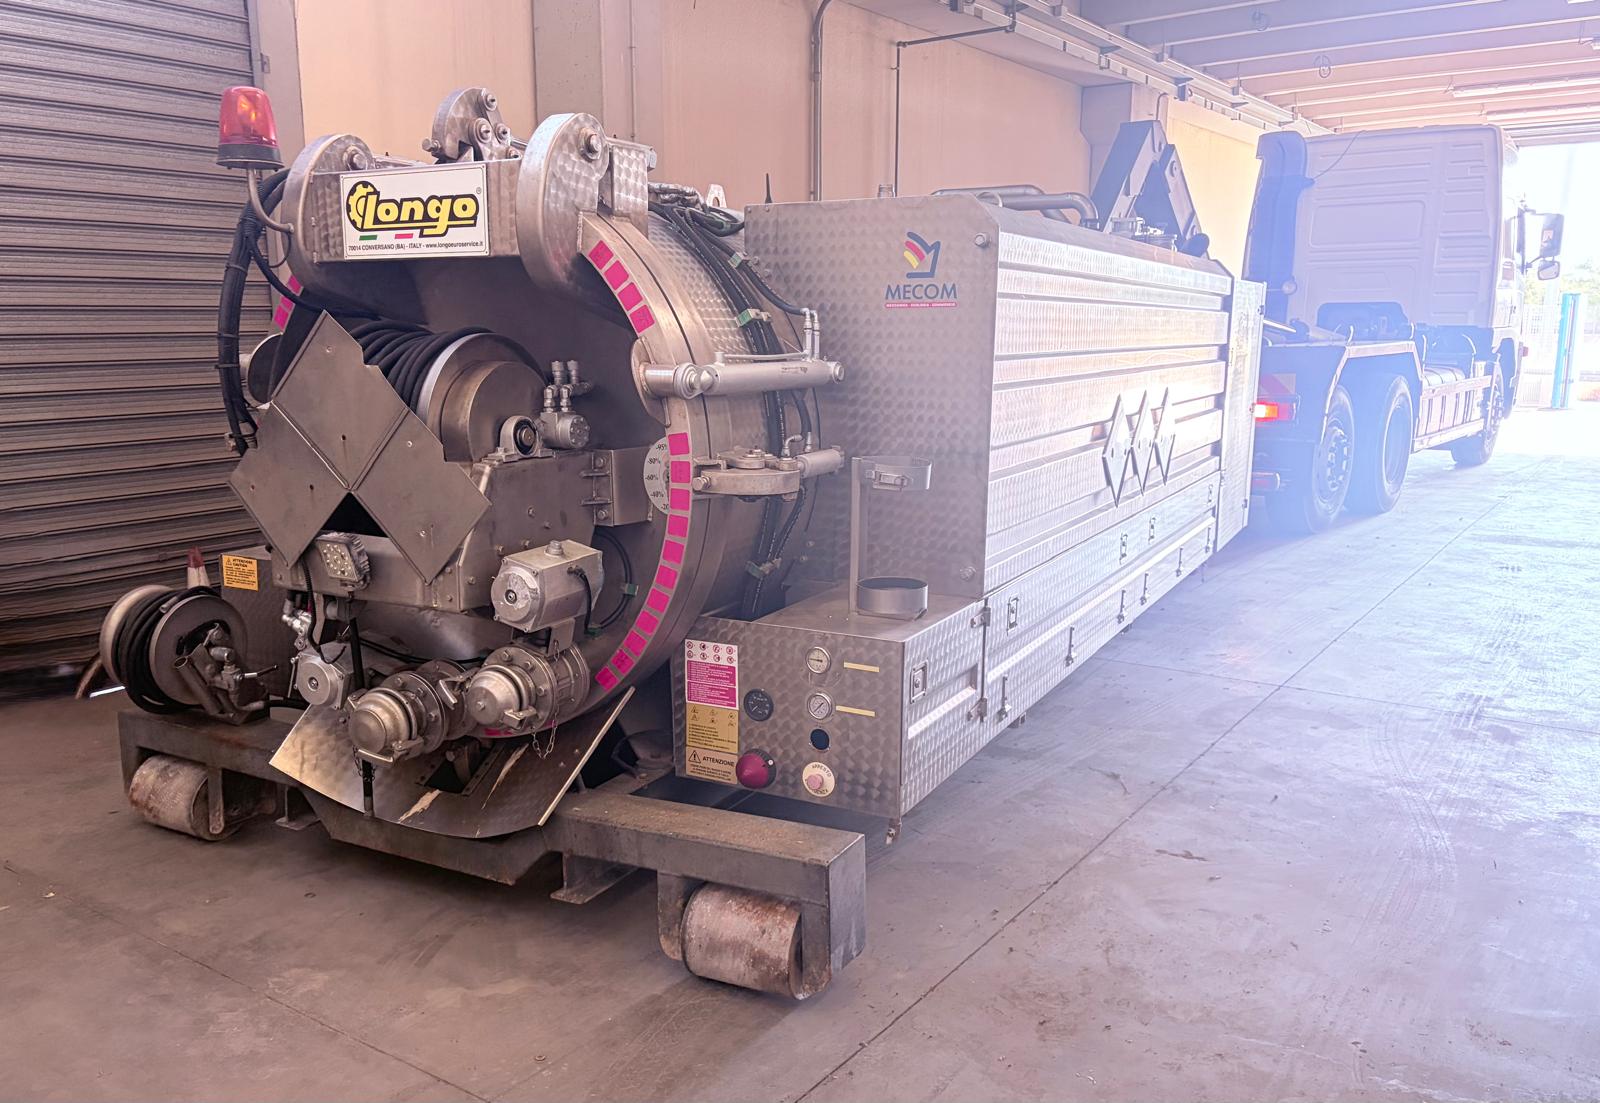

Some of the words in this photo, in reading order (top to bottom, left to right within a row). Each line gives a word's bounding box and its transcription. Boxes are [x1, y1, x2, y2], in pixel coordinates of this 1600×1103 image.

[361, 243, 394, 251] CONVERSANO
[425, 240, 483, 249] www.longoeuroservice.it
[885, 283, 957, 300] MECOM
[702, 756, 735, 767] ATTENZIONE
